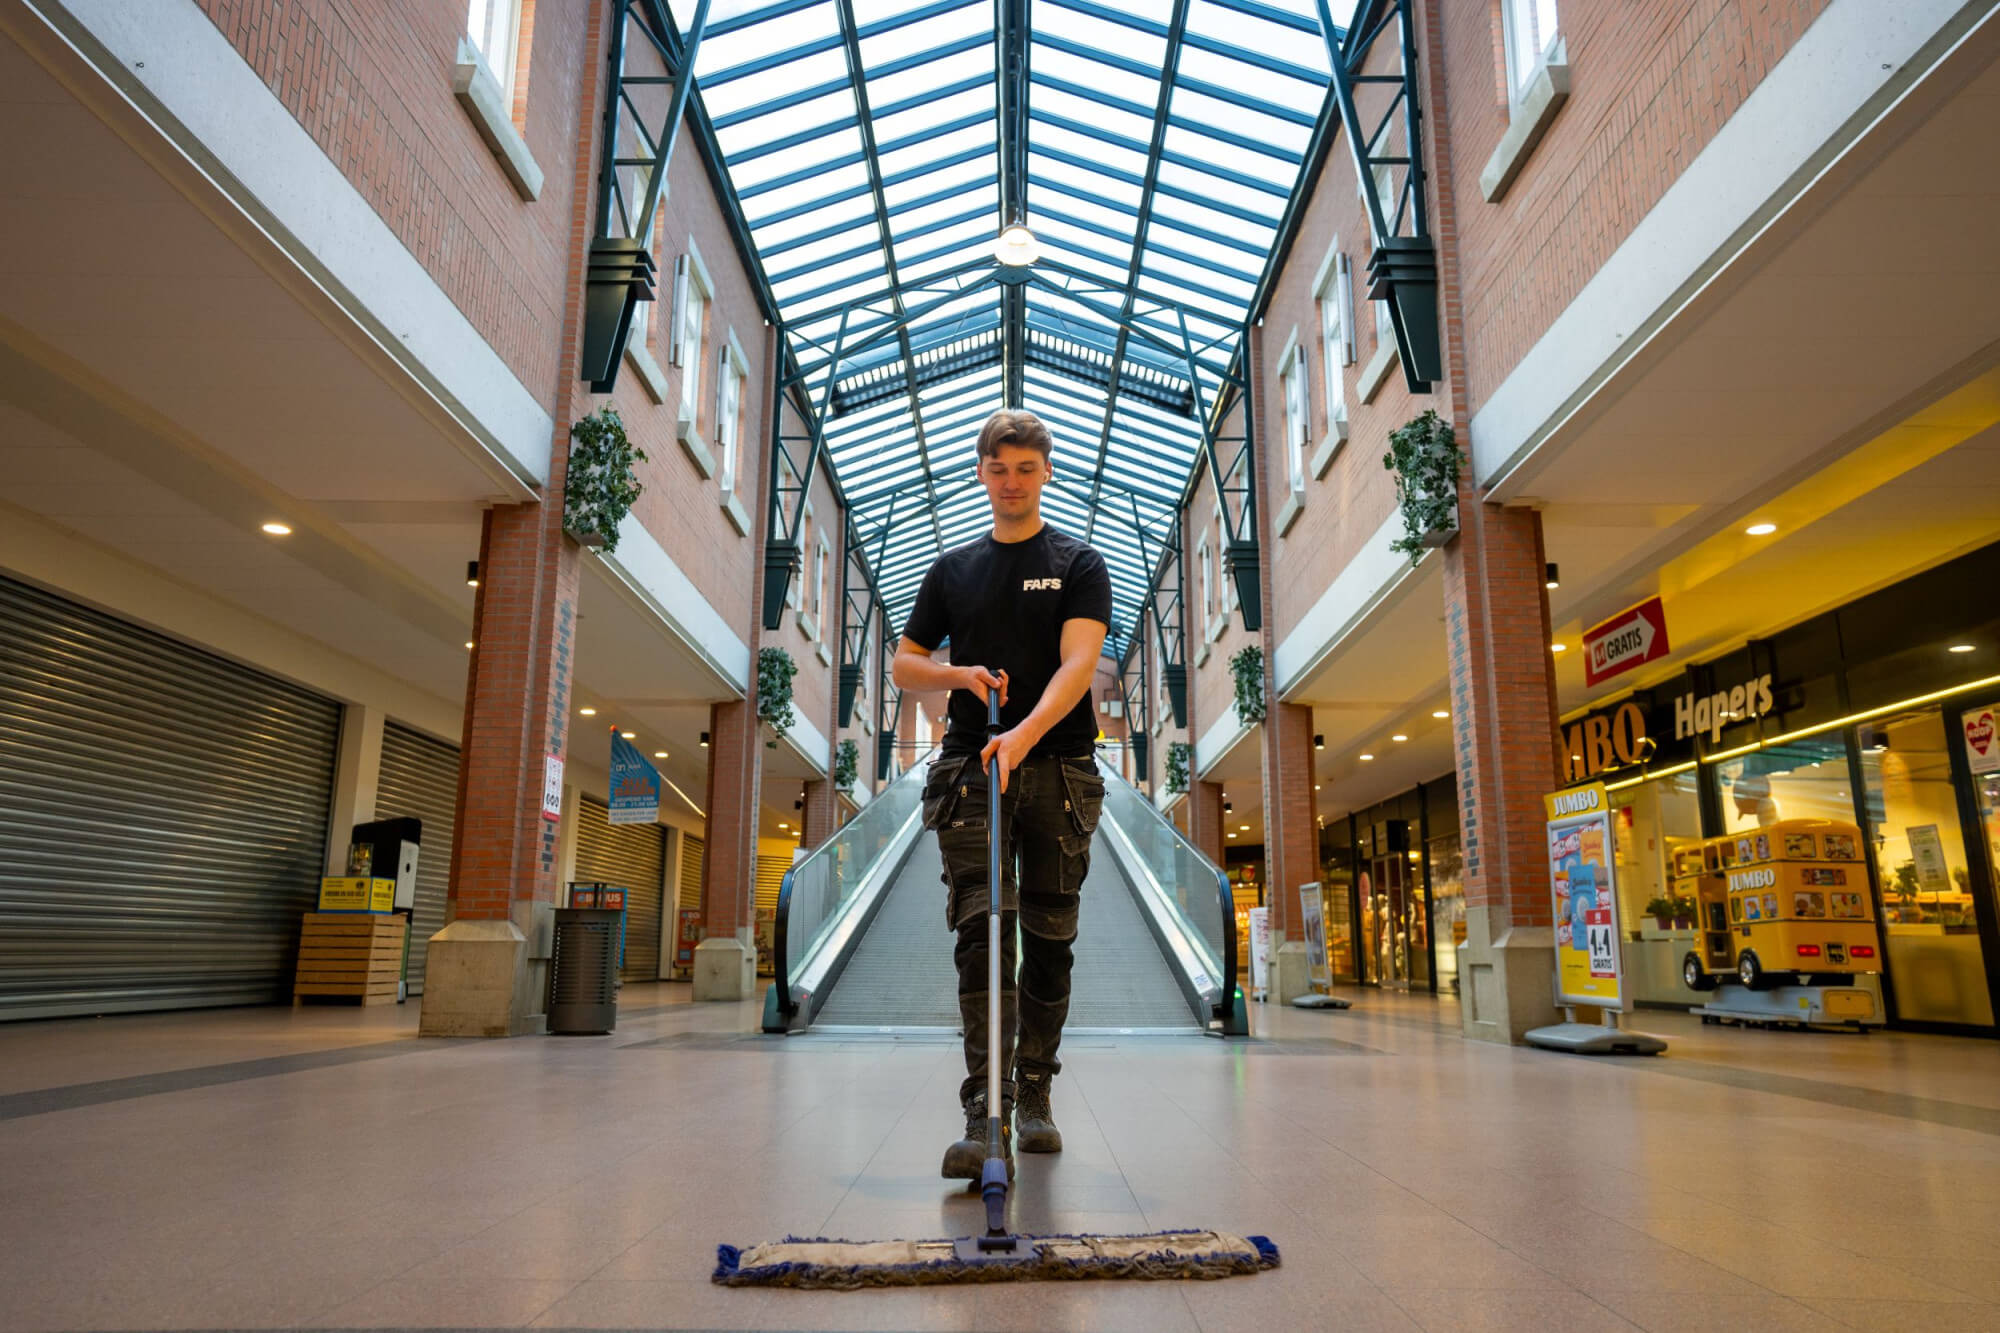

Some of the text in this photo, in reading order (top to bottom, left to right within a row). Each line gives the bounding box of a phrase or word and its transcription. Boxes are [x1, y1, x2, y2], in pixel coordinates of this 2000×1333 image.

[1023, 578, 1062, 591] FAFS
[1607, 627, 1642, 660] GRATIS
[1675, 674, 1773, 743] Hapers
[1553, 789, 1599, 816] JUMBO
[1729, 868, 1775, 893] JUMBO
